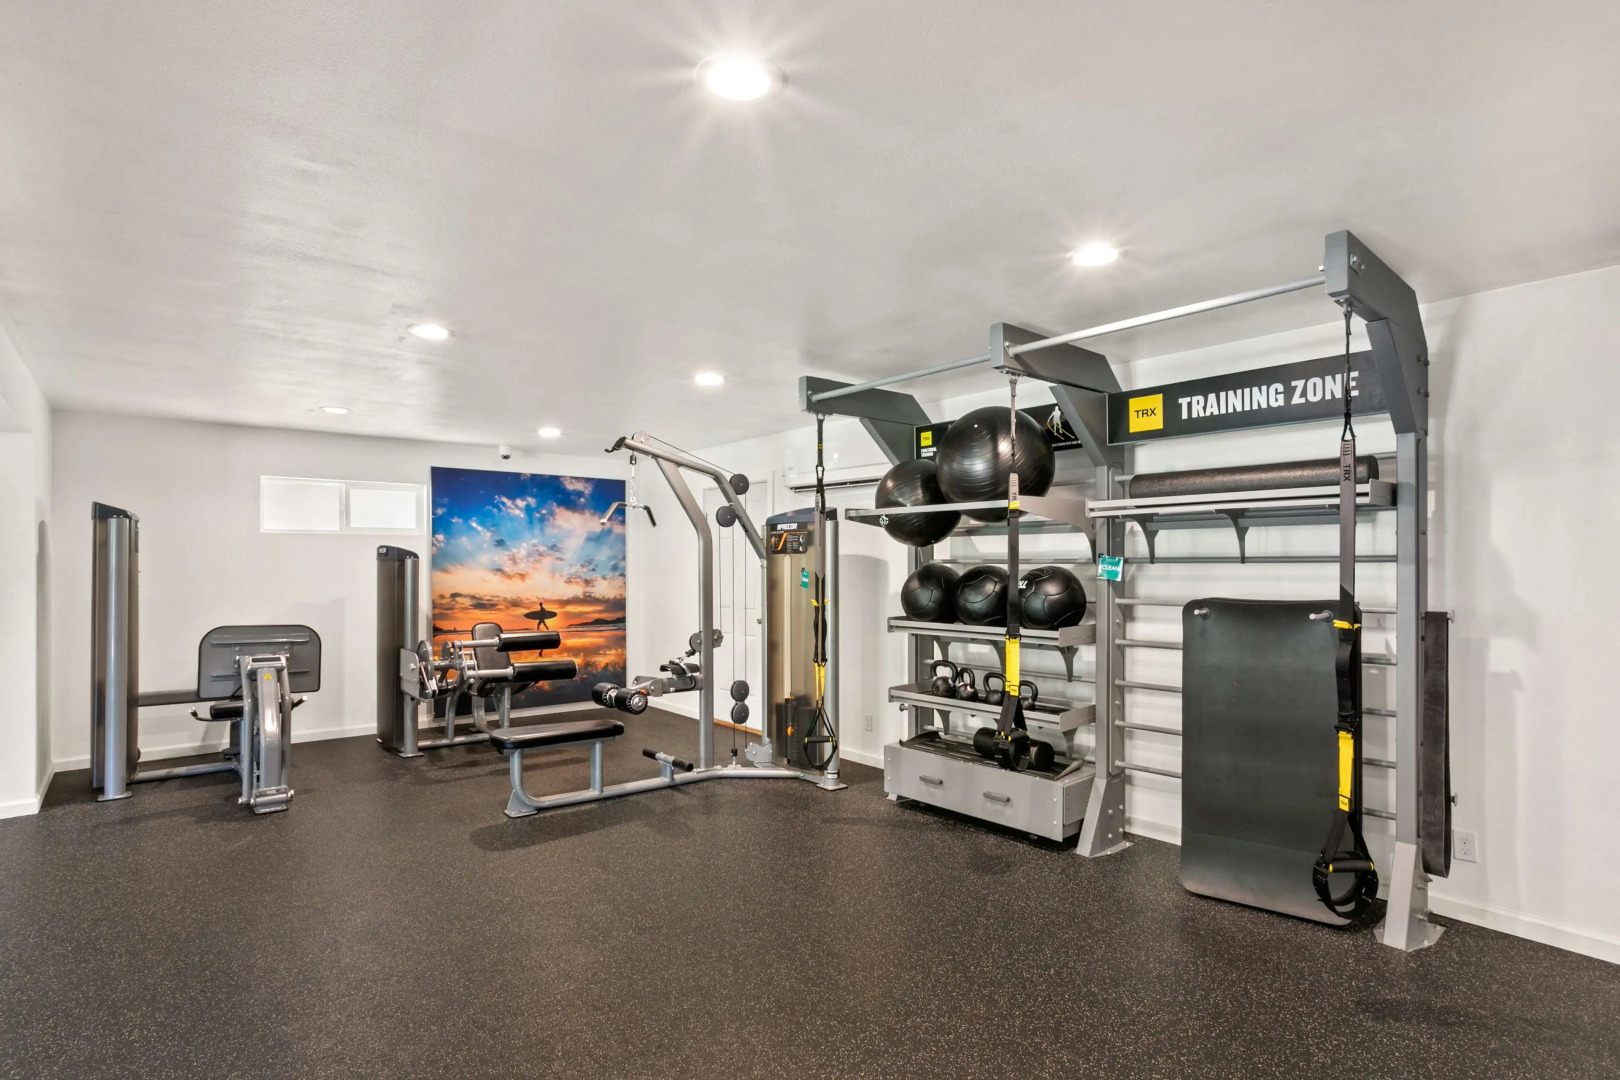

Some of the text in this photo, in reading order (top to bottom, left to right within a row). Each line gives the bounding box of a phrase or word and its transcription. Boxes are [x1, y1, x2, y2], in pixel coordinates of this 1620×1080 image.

[1178, 371, 1359, 420] TRAINING ZONE
[1134, 407, 1157, 419] TRX
[1343, 463, 1351, 482] TRX
